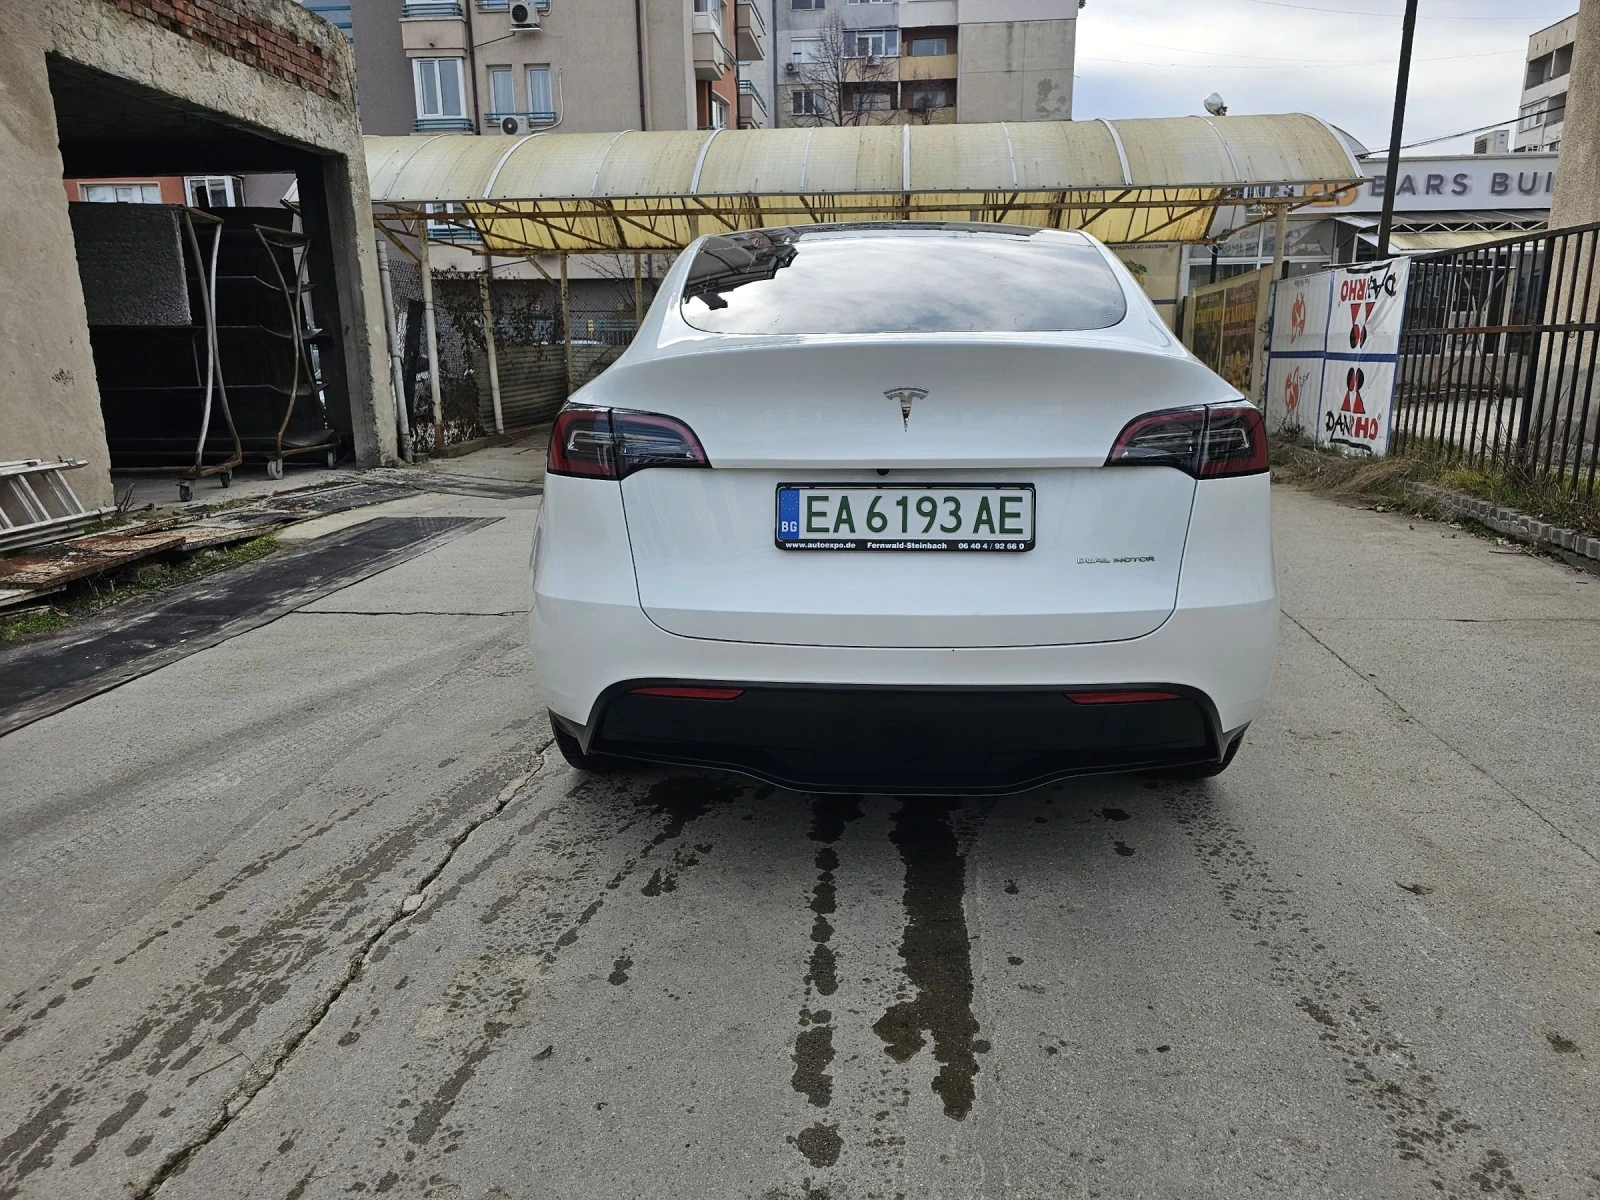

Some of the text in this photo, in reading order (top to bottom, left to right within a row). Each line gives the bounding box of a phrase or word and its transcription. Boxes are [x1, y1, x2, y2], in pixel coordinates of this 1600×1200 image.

[1370, 173, 1469, 197] BARS
[806, 495, 1023, 534] EA 6193 AE
[781, 521, 798, 533] BG
[785, 541, 856, 551] www.autoexpo.de
[867, 541, 948, 550] Fernwald-Steinbach
[958, 542, 969, 550] 06
[970, 542, 981, 550] 40
[982, 542, 988, 550] 4
